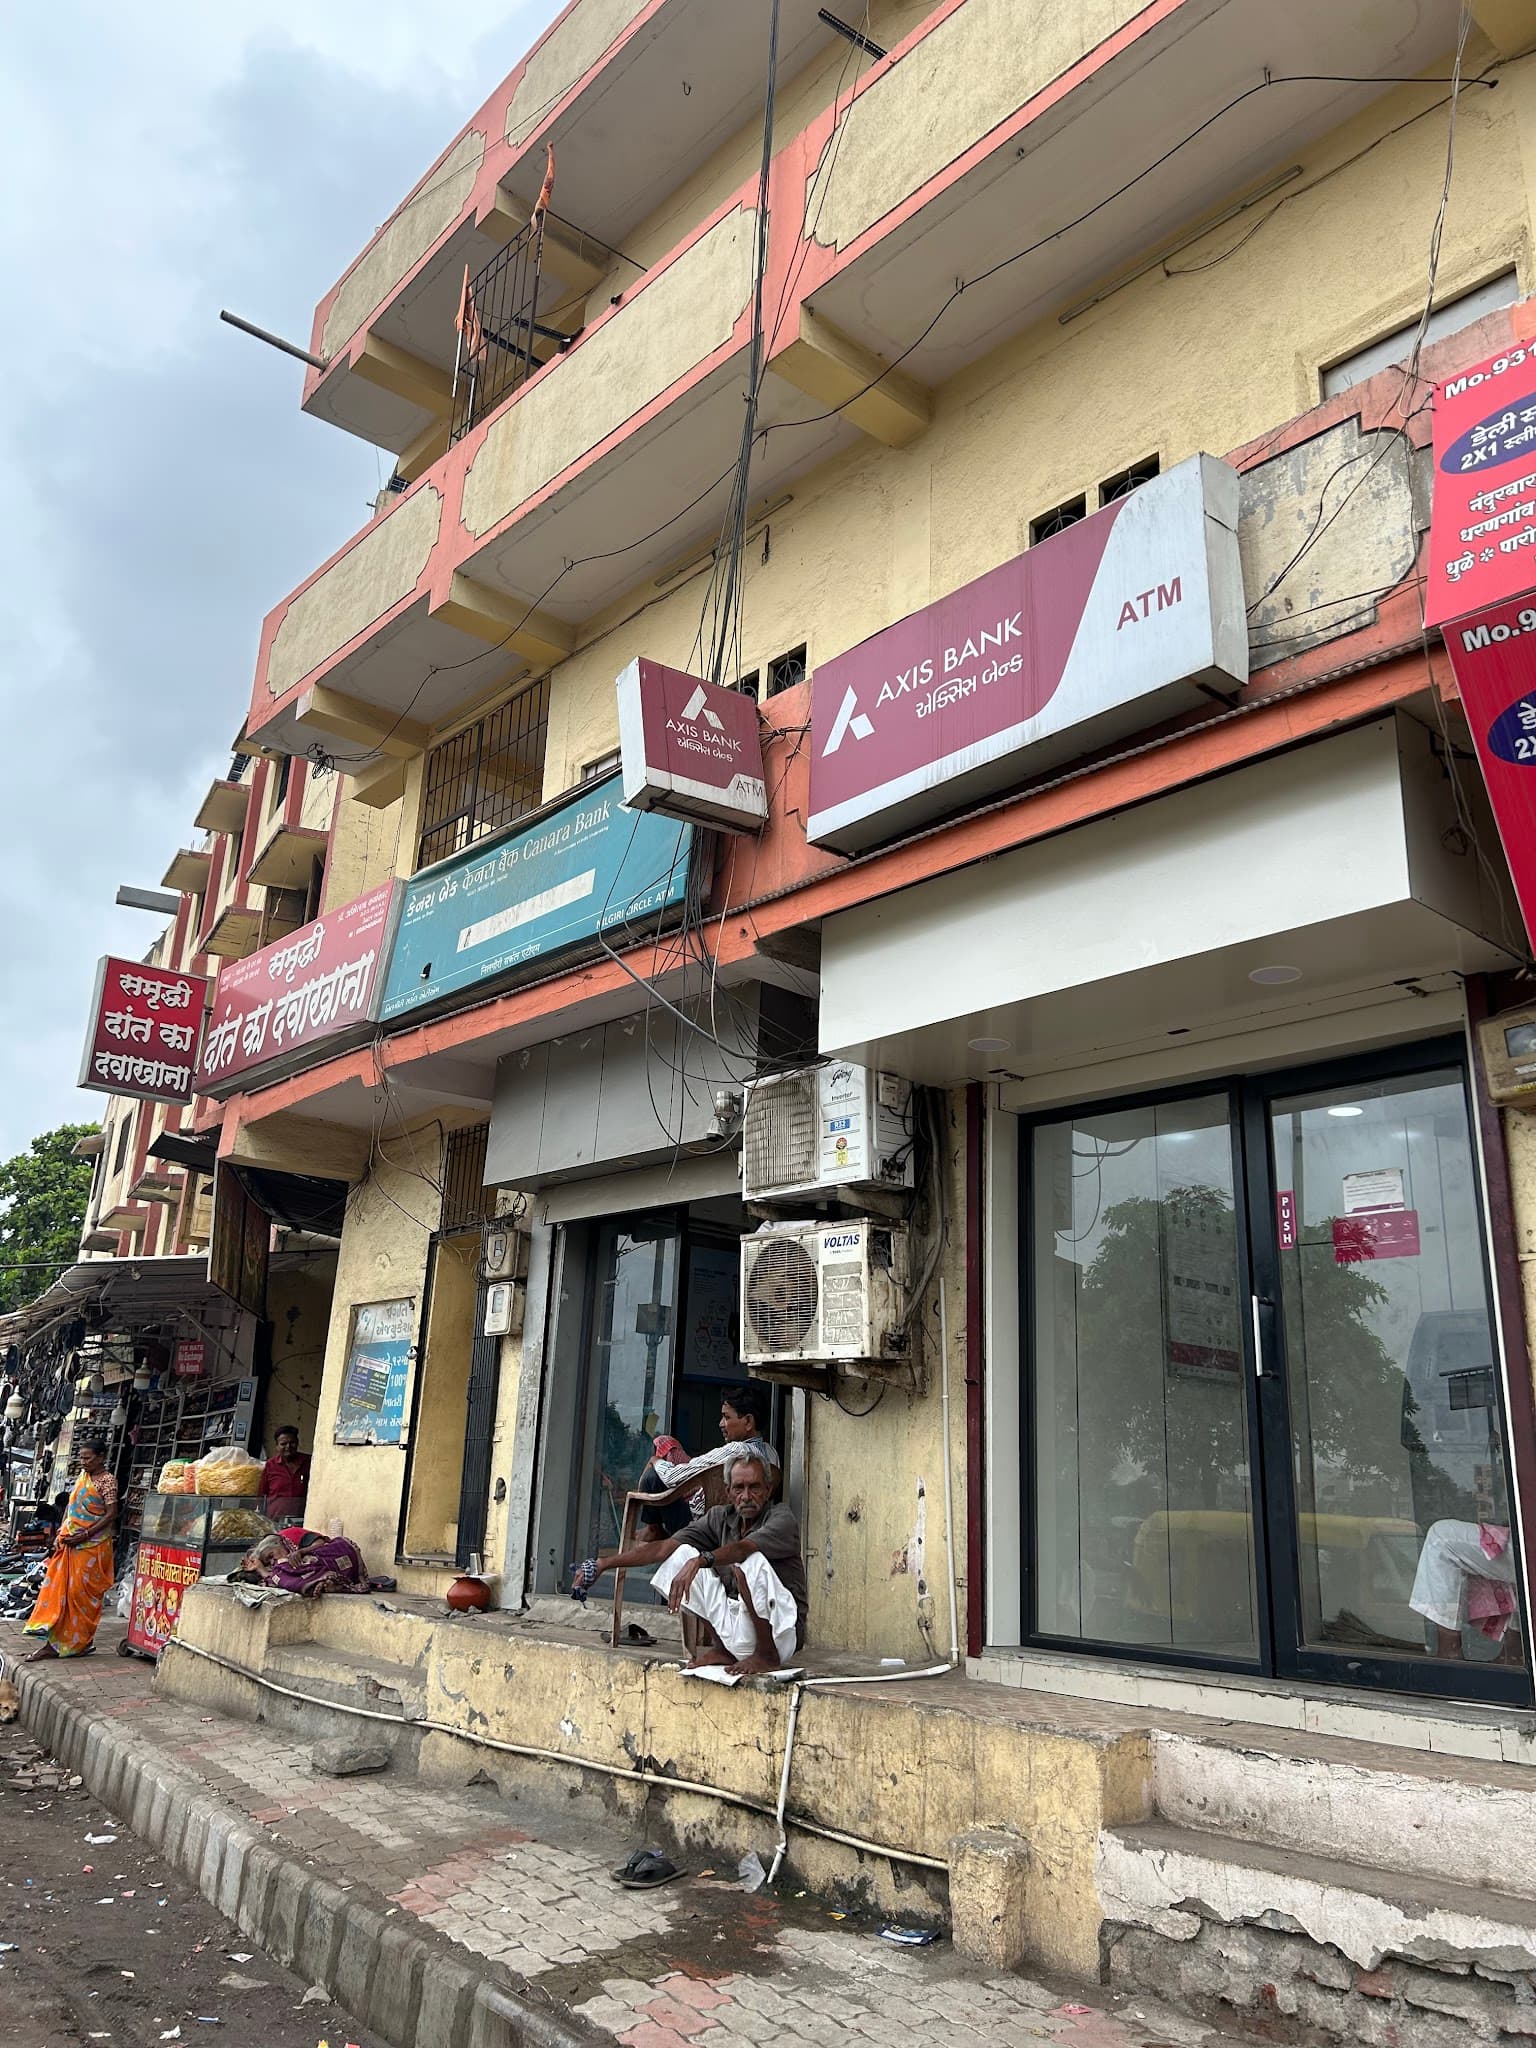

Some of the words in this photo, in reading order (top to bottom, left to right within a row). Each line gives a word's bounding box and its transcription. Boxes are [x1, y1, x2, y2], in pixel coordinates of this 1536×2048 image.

[1445, 340, 1536, 400] Mo.931
[1471, 411, 1518, 447] डेली
[1460, 441, 1497, 471] 2X1
[1469, 474, 1536, 514] नंदुरबार
[1460, 500, 1535, 543] धरणगांव
[1446, 551, 1475, 583] धुळे
[1500, 523, 1536, 554] पारो
[1116, 577, 1182, 631] ATM
[1461, 608, 1536, 653] Mo.9
[876, 659, 934, 709] AXIS
[943, 611, 1024, 675] BANK
[915, 673, 978, 719] એક્સિસ
[665, 718, 698, 738] AXIS
[702, 729, 742, 753] BANK
[735, 778, 763, 799] ATM
[406, 893, 435, 918] કેનરા
[462, 859, 496, 891] केनरा
[498, 848, 519, 873] बैंक
[523, 823, 571, 861] Canara
[574, 799, 611, 835] Bank
[596, 909, 625, 930] NILGIRI
[626, 896, 653, 916] CIRCLE
[655, 886, 675, 904] ATM
[268, 922, 325, 984] समृद्धी
[119, 973, 193, 1009] समृद्धी
[204, 1004, 242, 1074] दांत
[242, 998, 272, 1057] का
[272, 949, 375, 1042] दवाखाना
[105, 1005, 154, 1043] दांत
[160, 1021, 194, 1052] का
[95, 1051, 191, 1093] दवाखाना
[831, 1091, 853, 1101] Inverter
[823, 1233, 861, 1249] VOLTAS
[1281, 1196, 1292, 1244] PUSH
